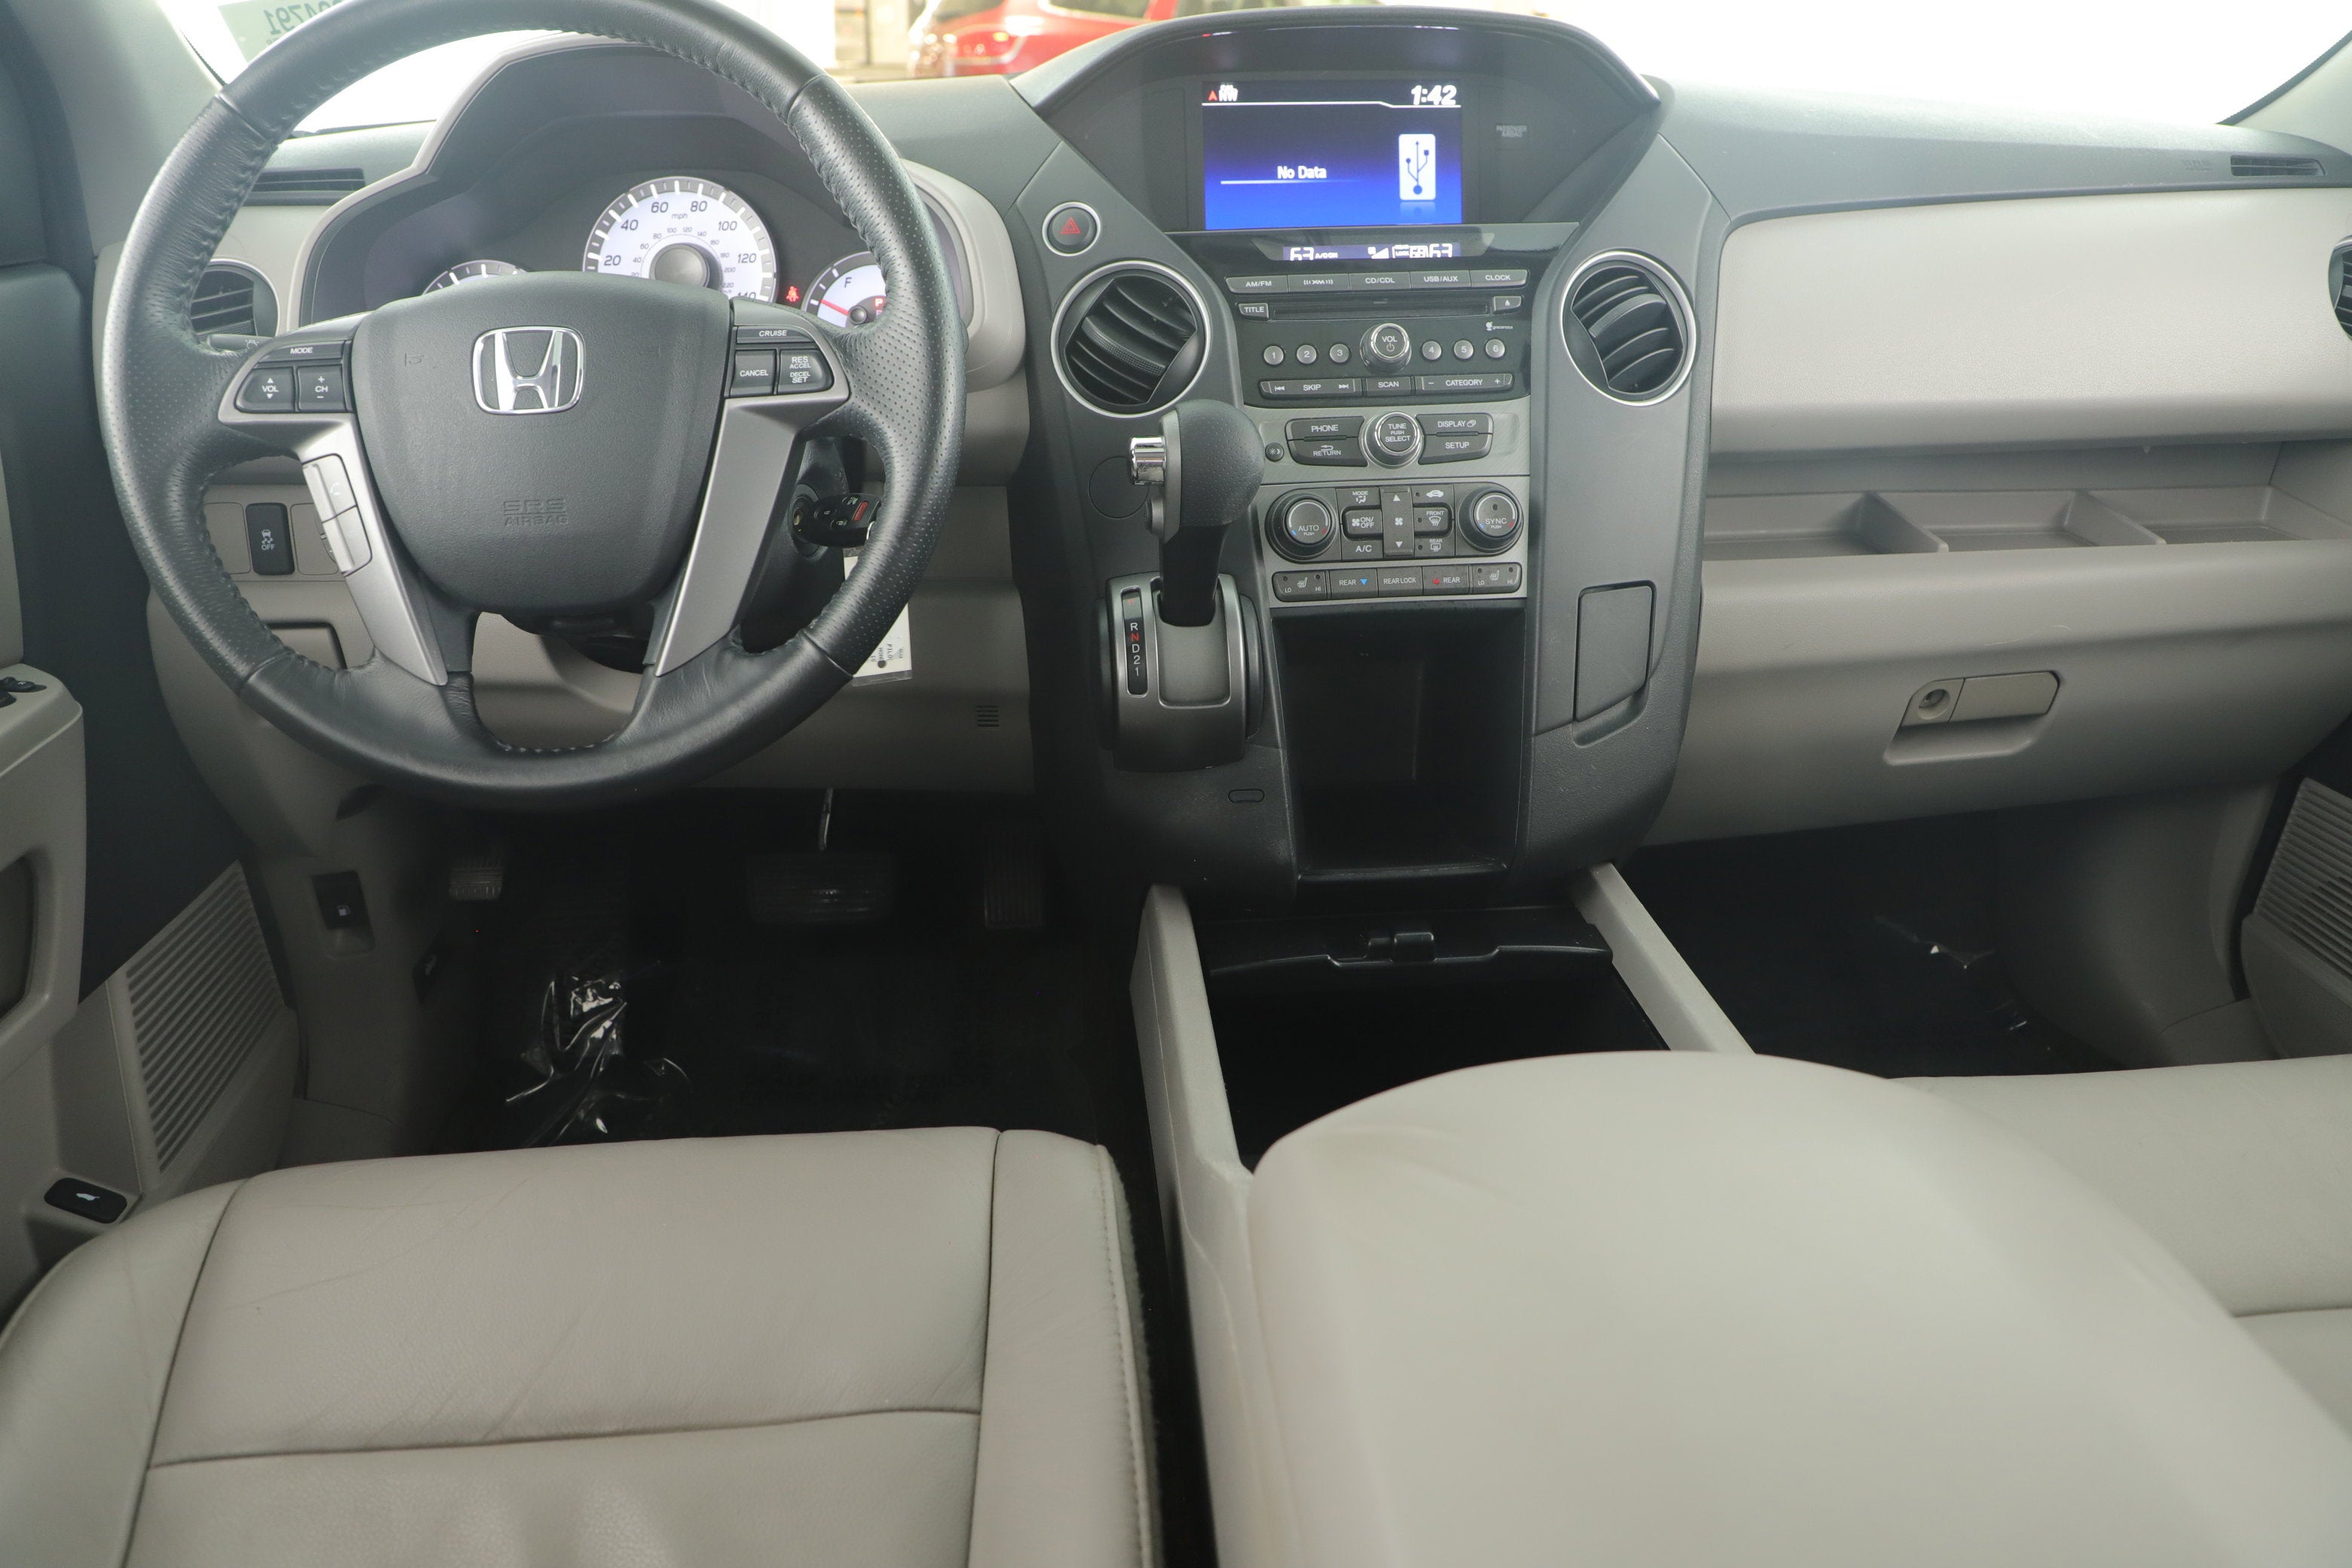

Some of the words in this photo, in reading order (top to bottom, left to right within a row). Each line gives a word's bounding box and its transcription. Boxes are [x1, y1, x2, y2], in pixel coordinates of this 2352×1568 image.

[1411, 85, 1457, 106] 1:42
[1277, 167, 1295, 179] No
[1298, 166, 1327, 179] Data
[651, 202, 669, 213] 60
[690, 201, 707, 212] 80
[621, 219, 639, 231] 40
[718, 221, 737, 231] 100
[604, 255, 621, 266] 20
[737, 253, 757, 263] 120
[845, 277, 852, 287] F
[875, 299, 884, 307] P
[1485, 517, 1507, 525] SYNC
[1131, 622, 1138, 631] R
[1131, 633, 1139, 642] N
[1132, 644, 1140, 653] D
[1133, 655, 1140, 664] 2
[1135, 666, 1139, 675] 1
